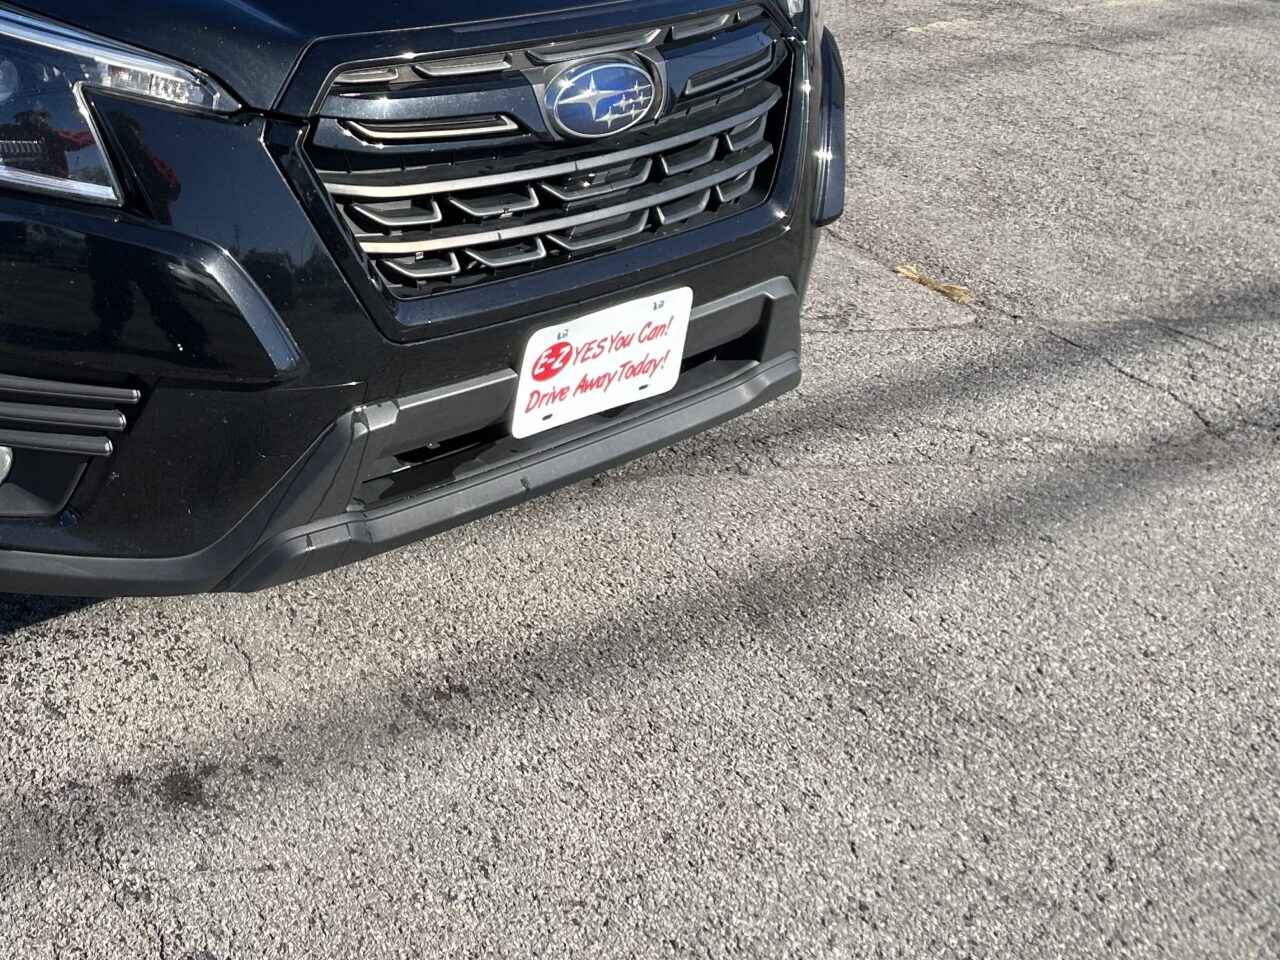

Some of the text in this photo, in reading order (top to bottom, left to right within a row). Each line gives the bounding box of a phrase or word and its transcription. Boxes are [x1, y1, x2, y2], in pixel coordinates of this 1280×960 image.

[533, 315, 674, 375] E-Z YES You Can!
[524, 349, 671, 413] Drive Away Today!
